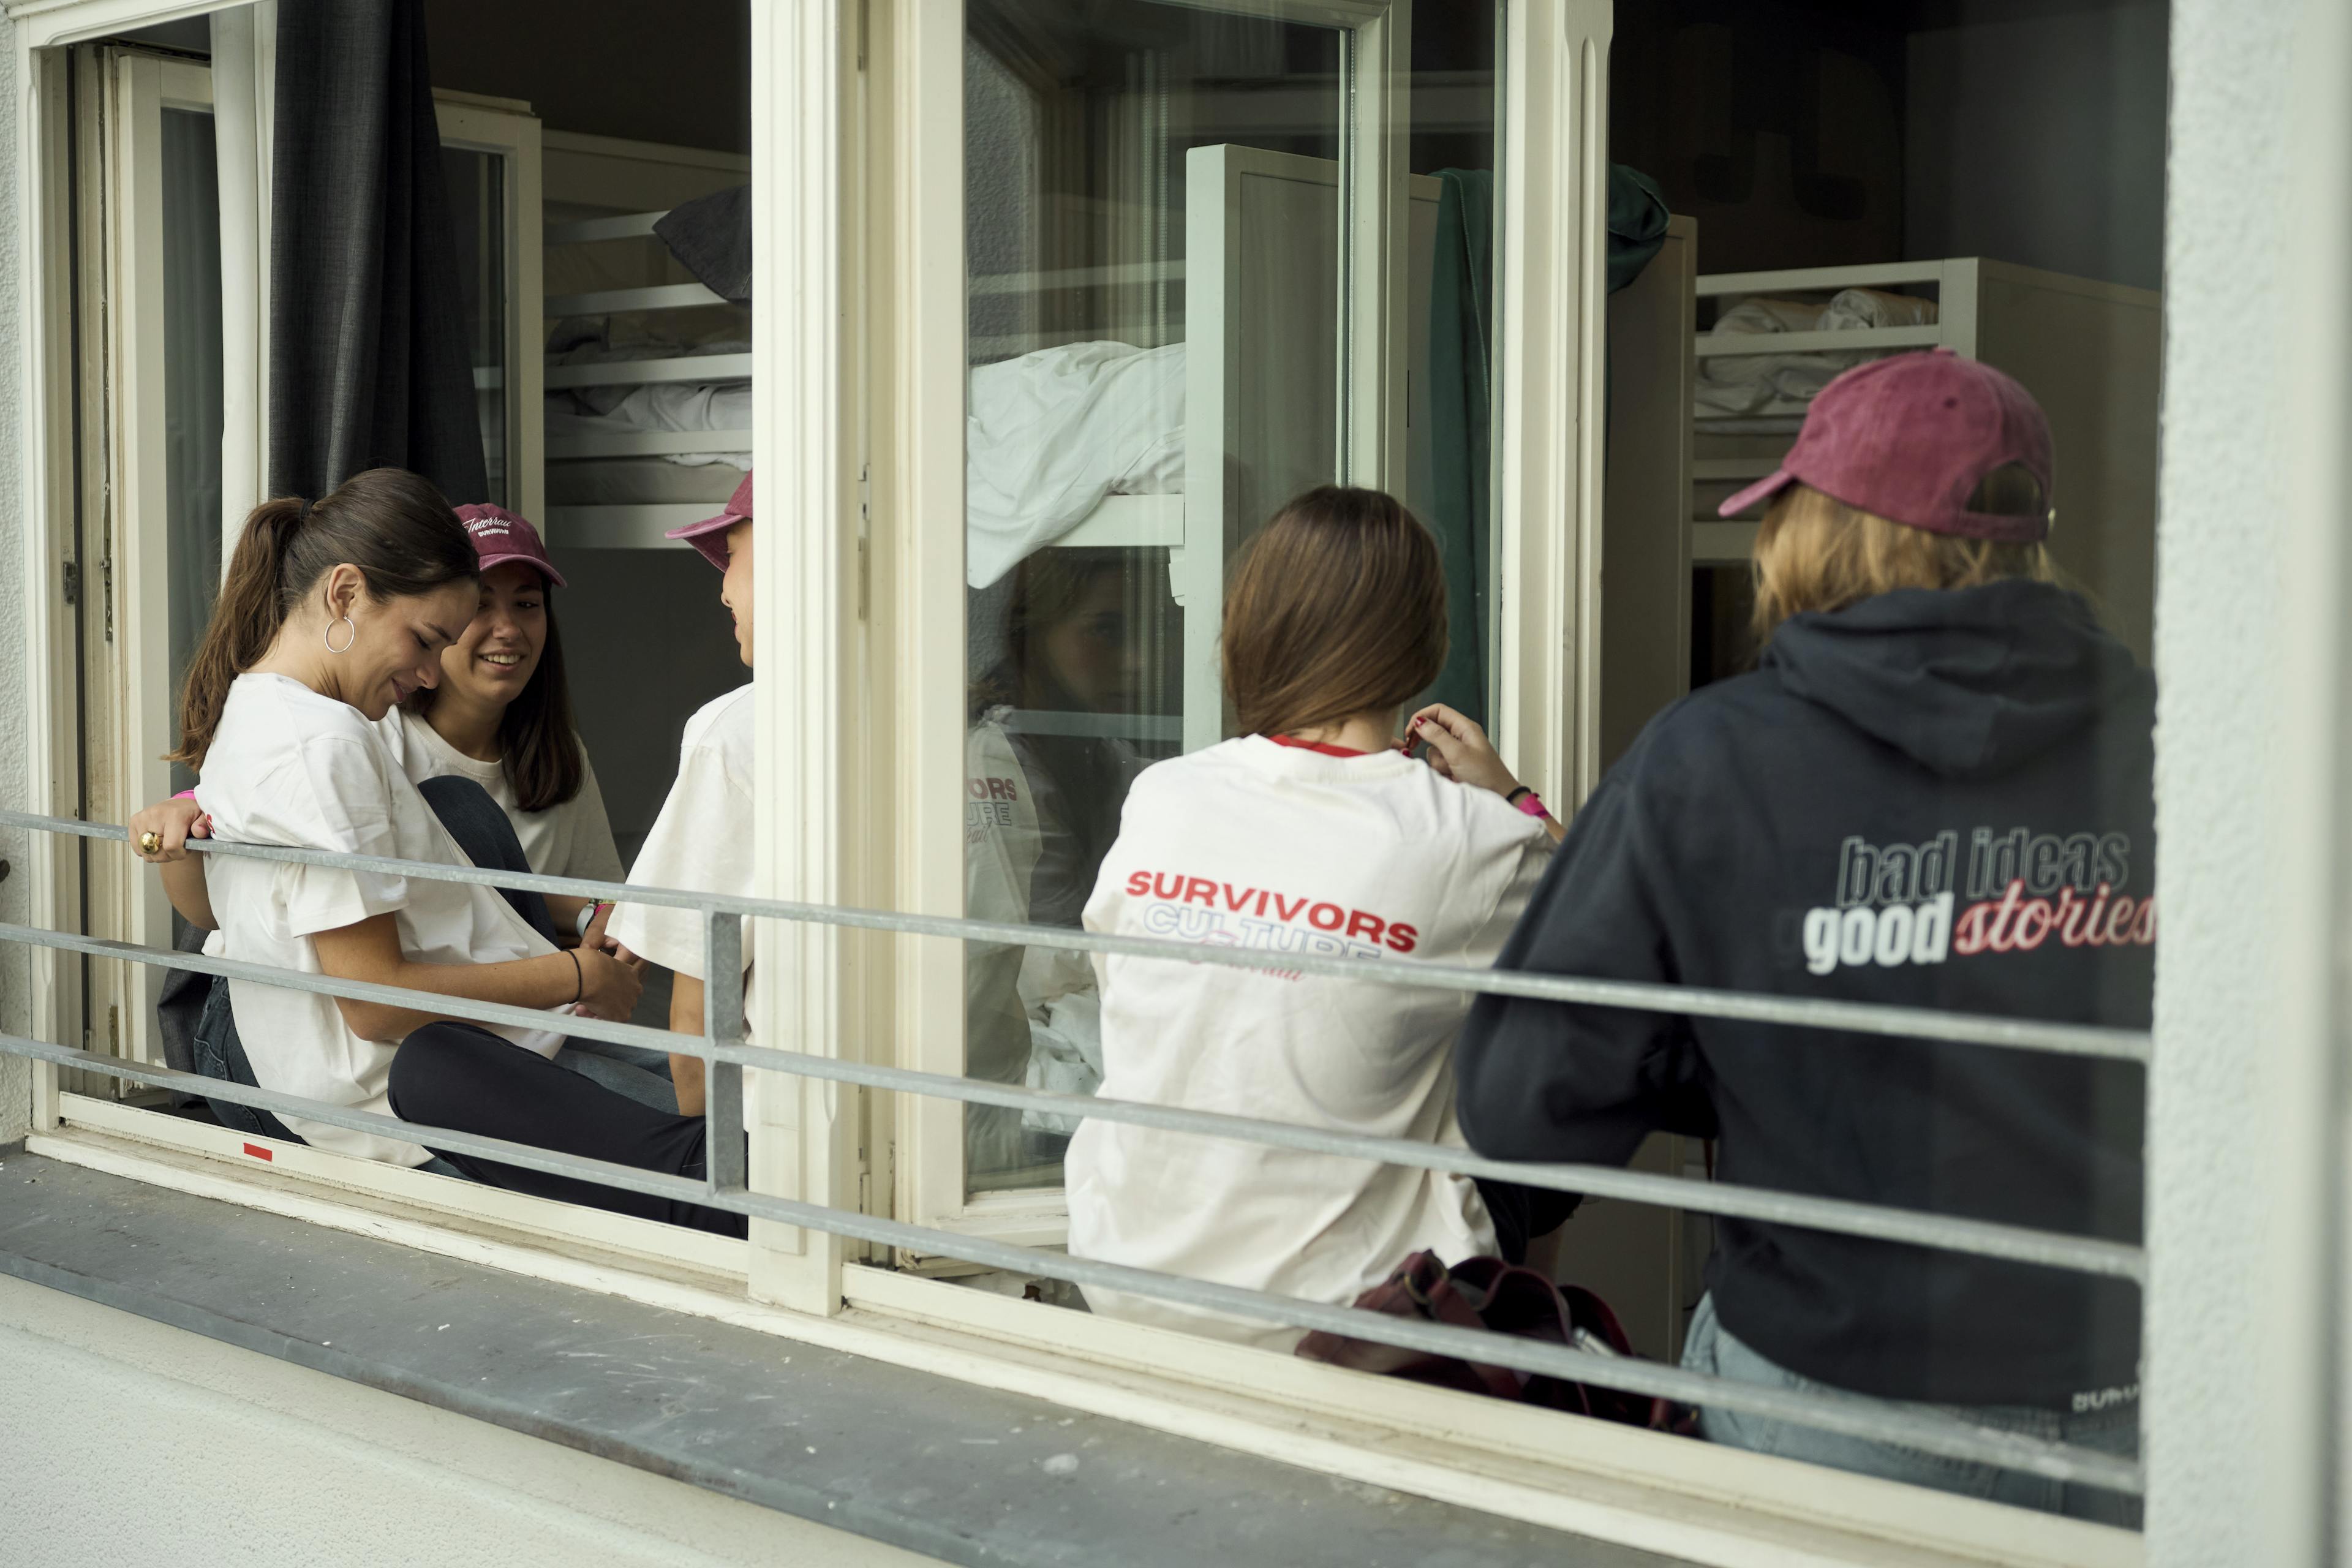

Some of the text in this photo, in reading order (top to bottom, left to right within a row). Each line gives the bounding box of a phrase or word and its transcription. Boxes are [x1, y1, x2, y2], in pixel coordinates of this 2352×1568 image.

[1837, 826, 2130, 908] bad ideas
[1126, 871, 1419, 953] SURVIVORS
[1803, 878, 2156, 975] good stories
